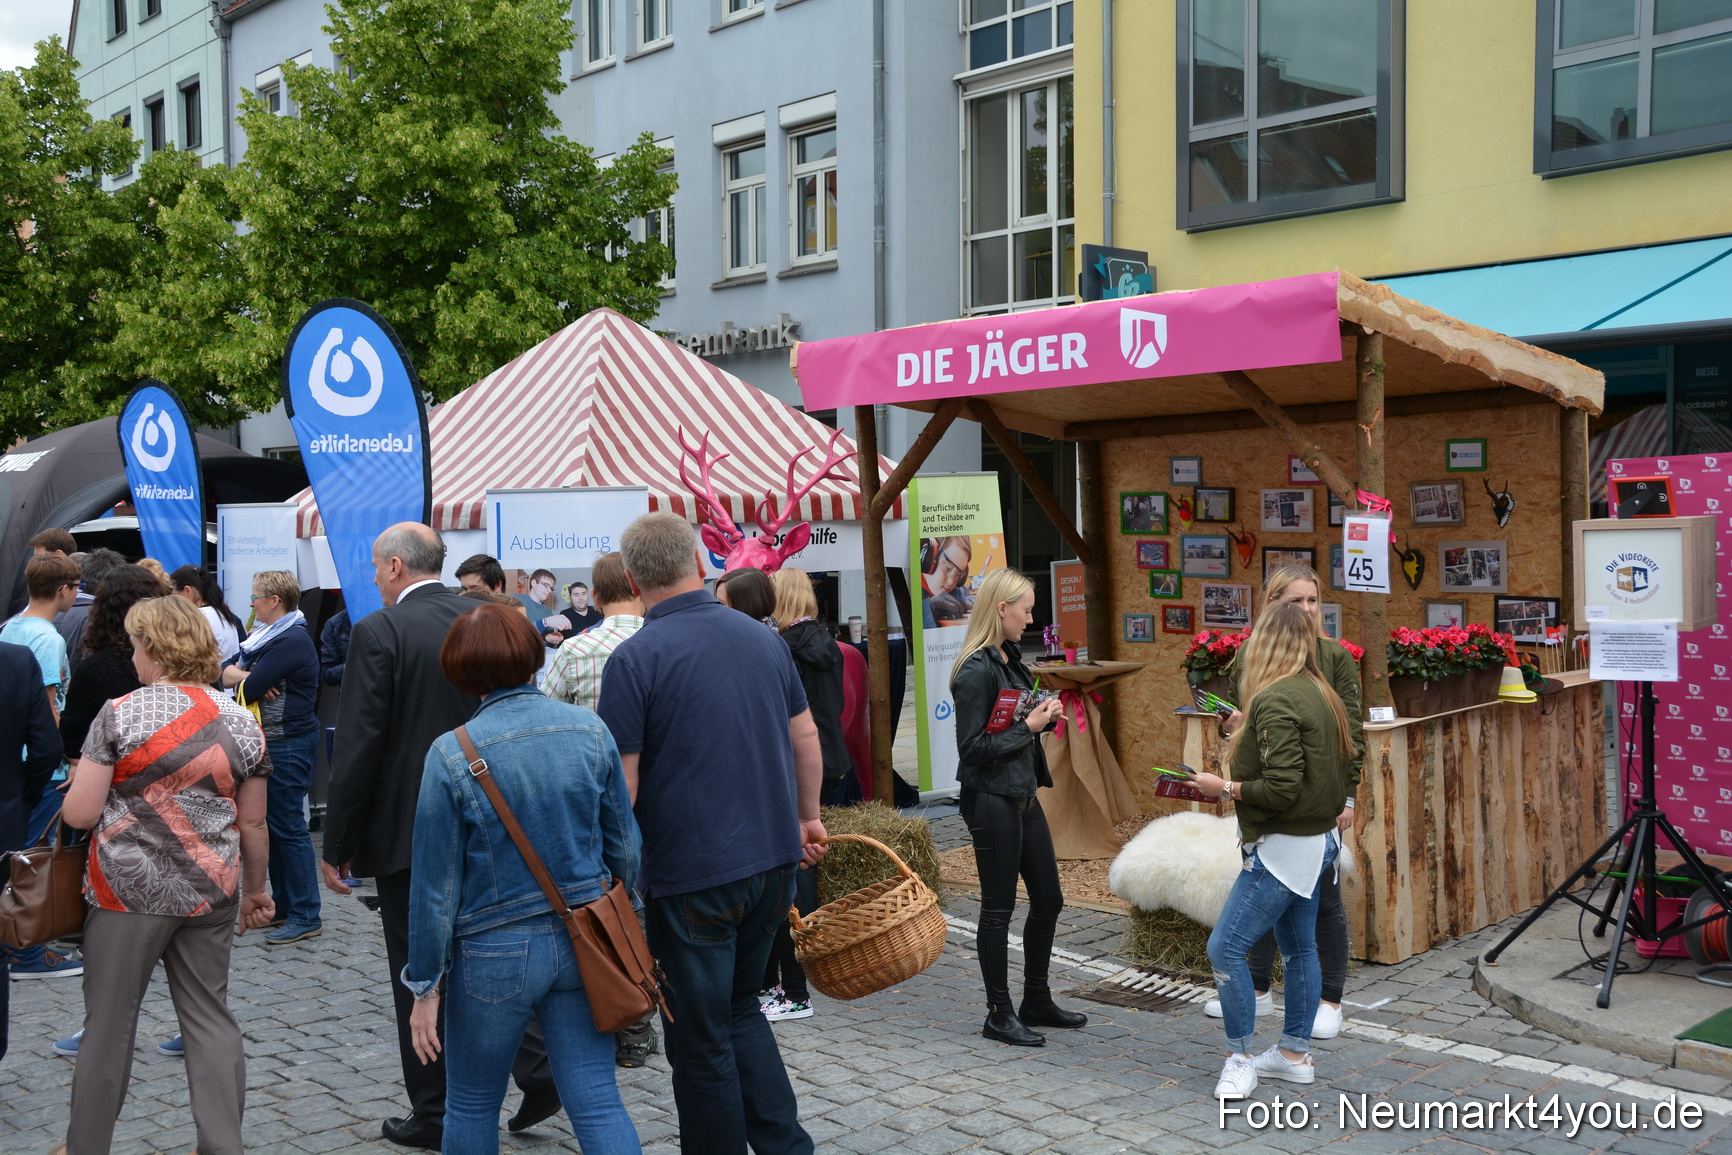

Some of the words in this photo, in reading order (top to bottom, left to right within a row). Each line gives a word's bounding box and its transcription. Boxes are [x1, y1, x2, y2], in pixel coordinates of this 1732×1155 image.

[897, 348, 954, 387] DIE
[966, 329, 1089, 385] JÄGER
[1696, 367, 1719, 376] DIESEL
[1686, 400, 1716, 408] adidas
[922, 504, 955, 512] Berufliche
[957, 503, 980, 512] Bildung
[937, 513, 963, 521] Teilhabe
[923, 524, 963, 533] Arbeitsleben
[510, 533, 611, 552] Ausbildung
[1605, 560, 1619, 572] DIE
[1618, 553, 1659, 572] VIDEOKISTE
[1348, 558, 1373, 581] 45
[1061, 586, 1072, 594] WEB
[927, 644, 939, 652] Wir
